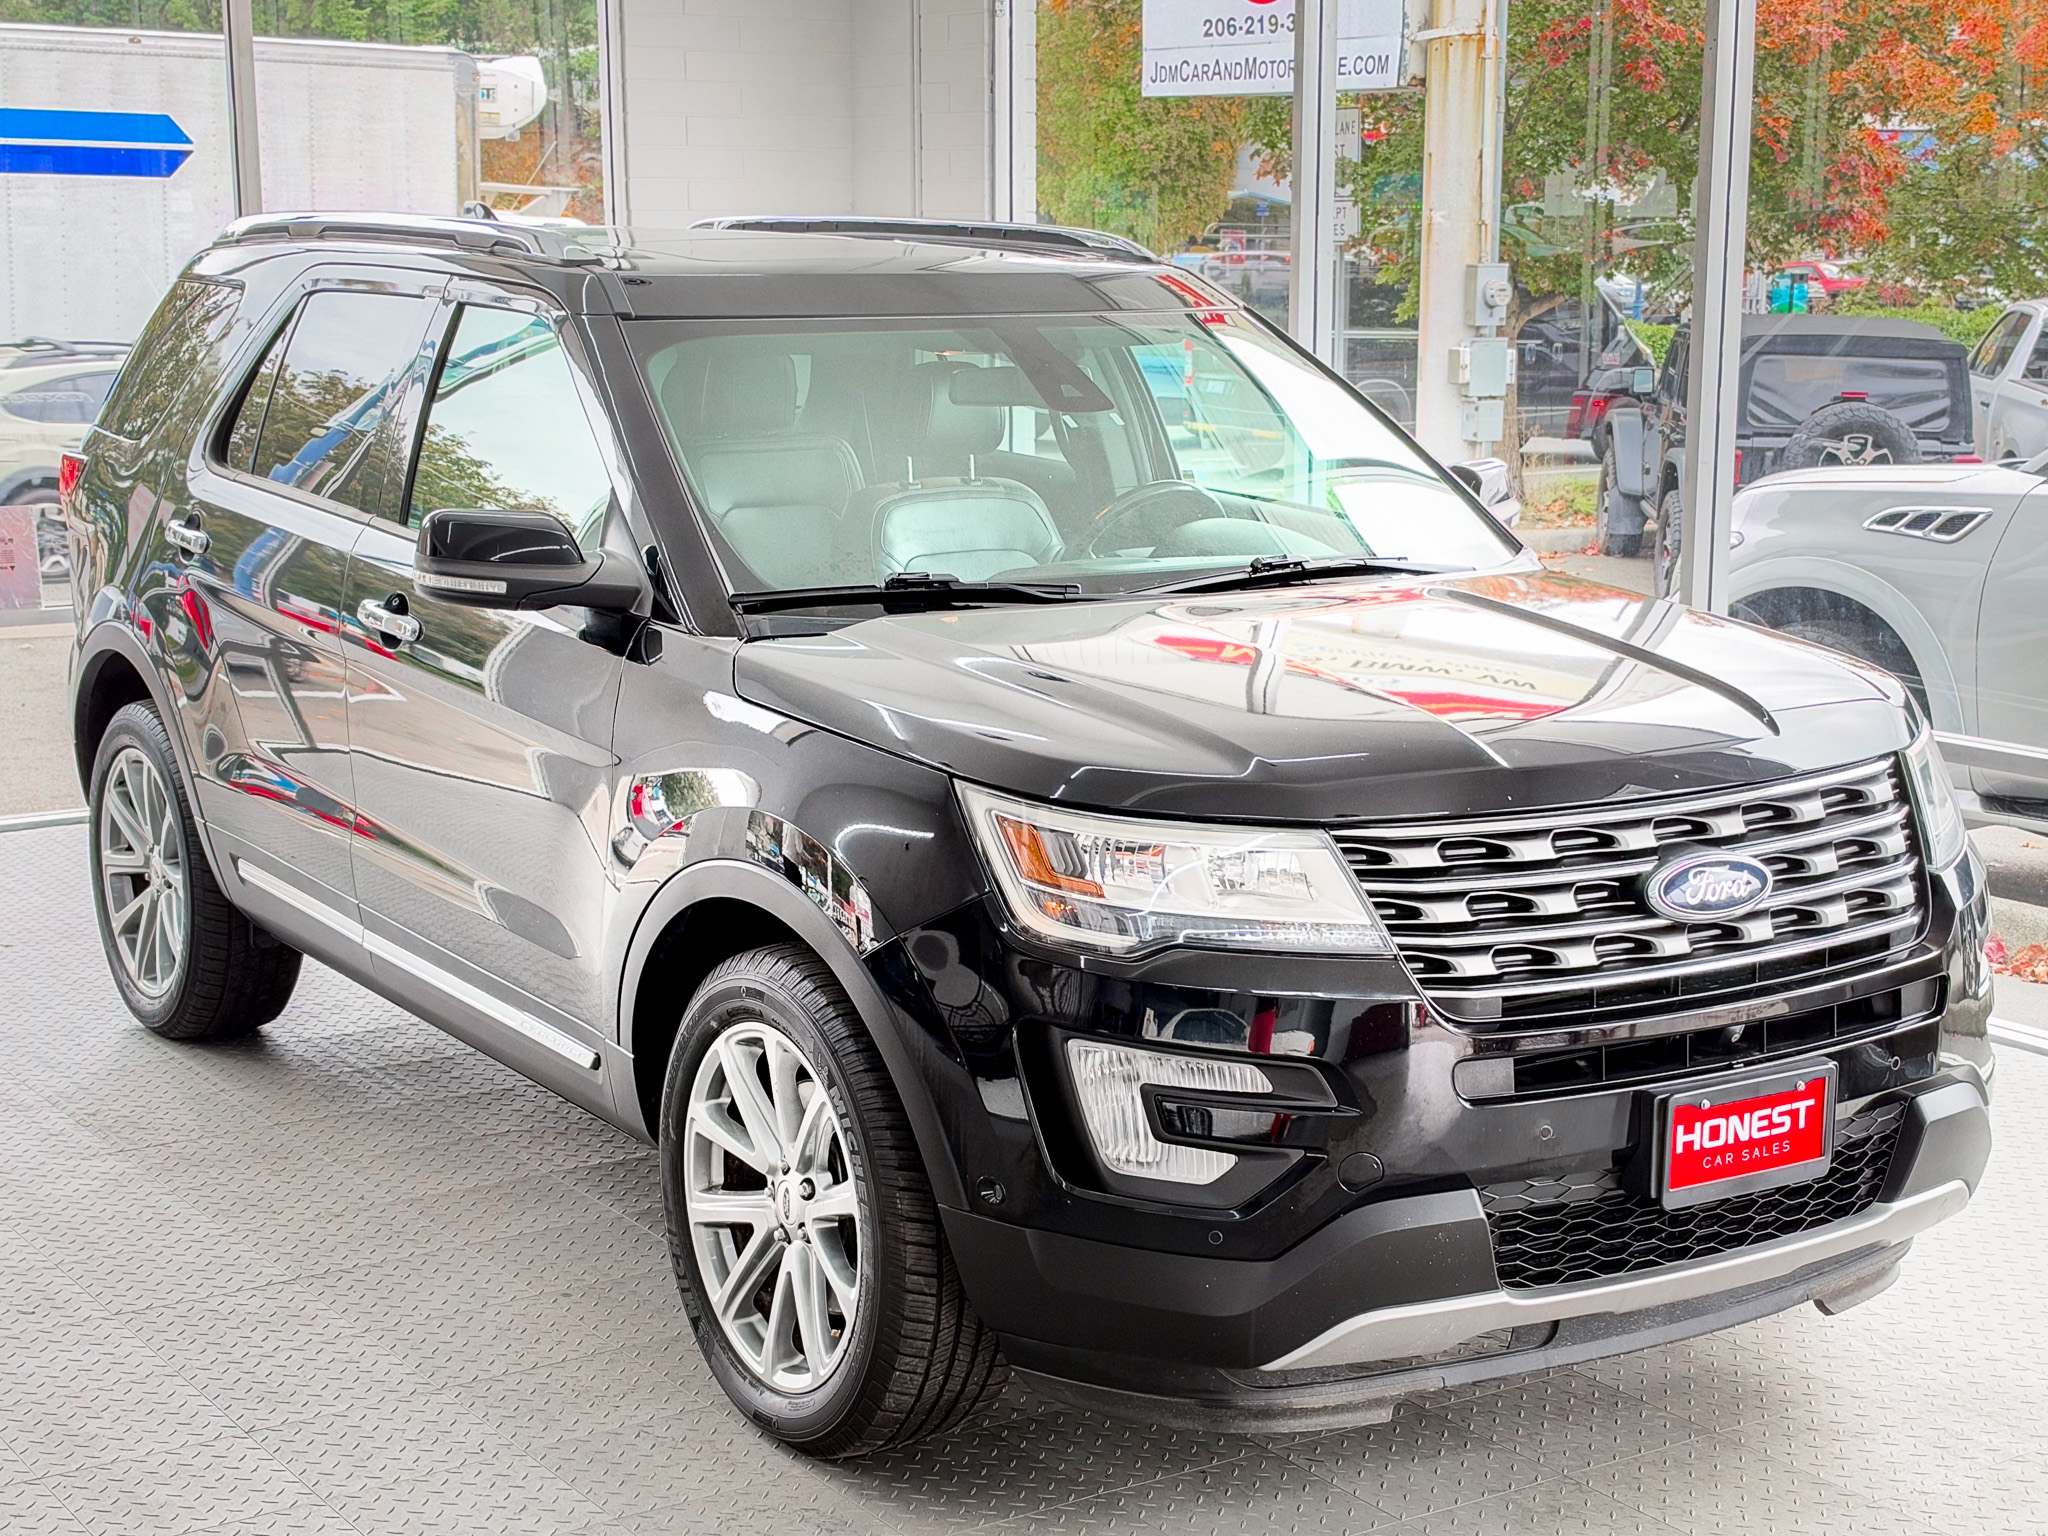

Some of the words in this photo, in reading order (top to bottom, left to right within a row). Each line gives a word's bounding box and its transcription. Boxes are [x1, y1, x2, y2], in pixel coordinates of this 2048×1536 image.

[1685, 864, 1752, 906] Ford
[1675, 1098, 1815, 1154] HONEST
[1702, 1152, 1734, 1169] CAR
[1741, 1140, 1791, 1162] SALES
